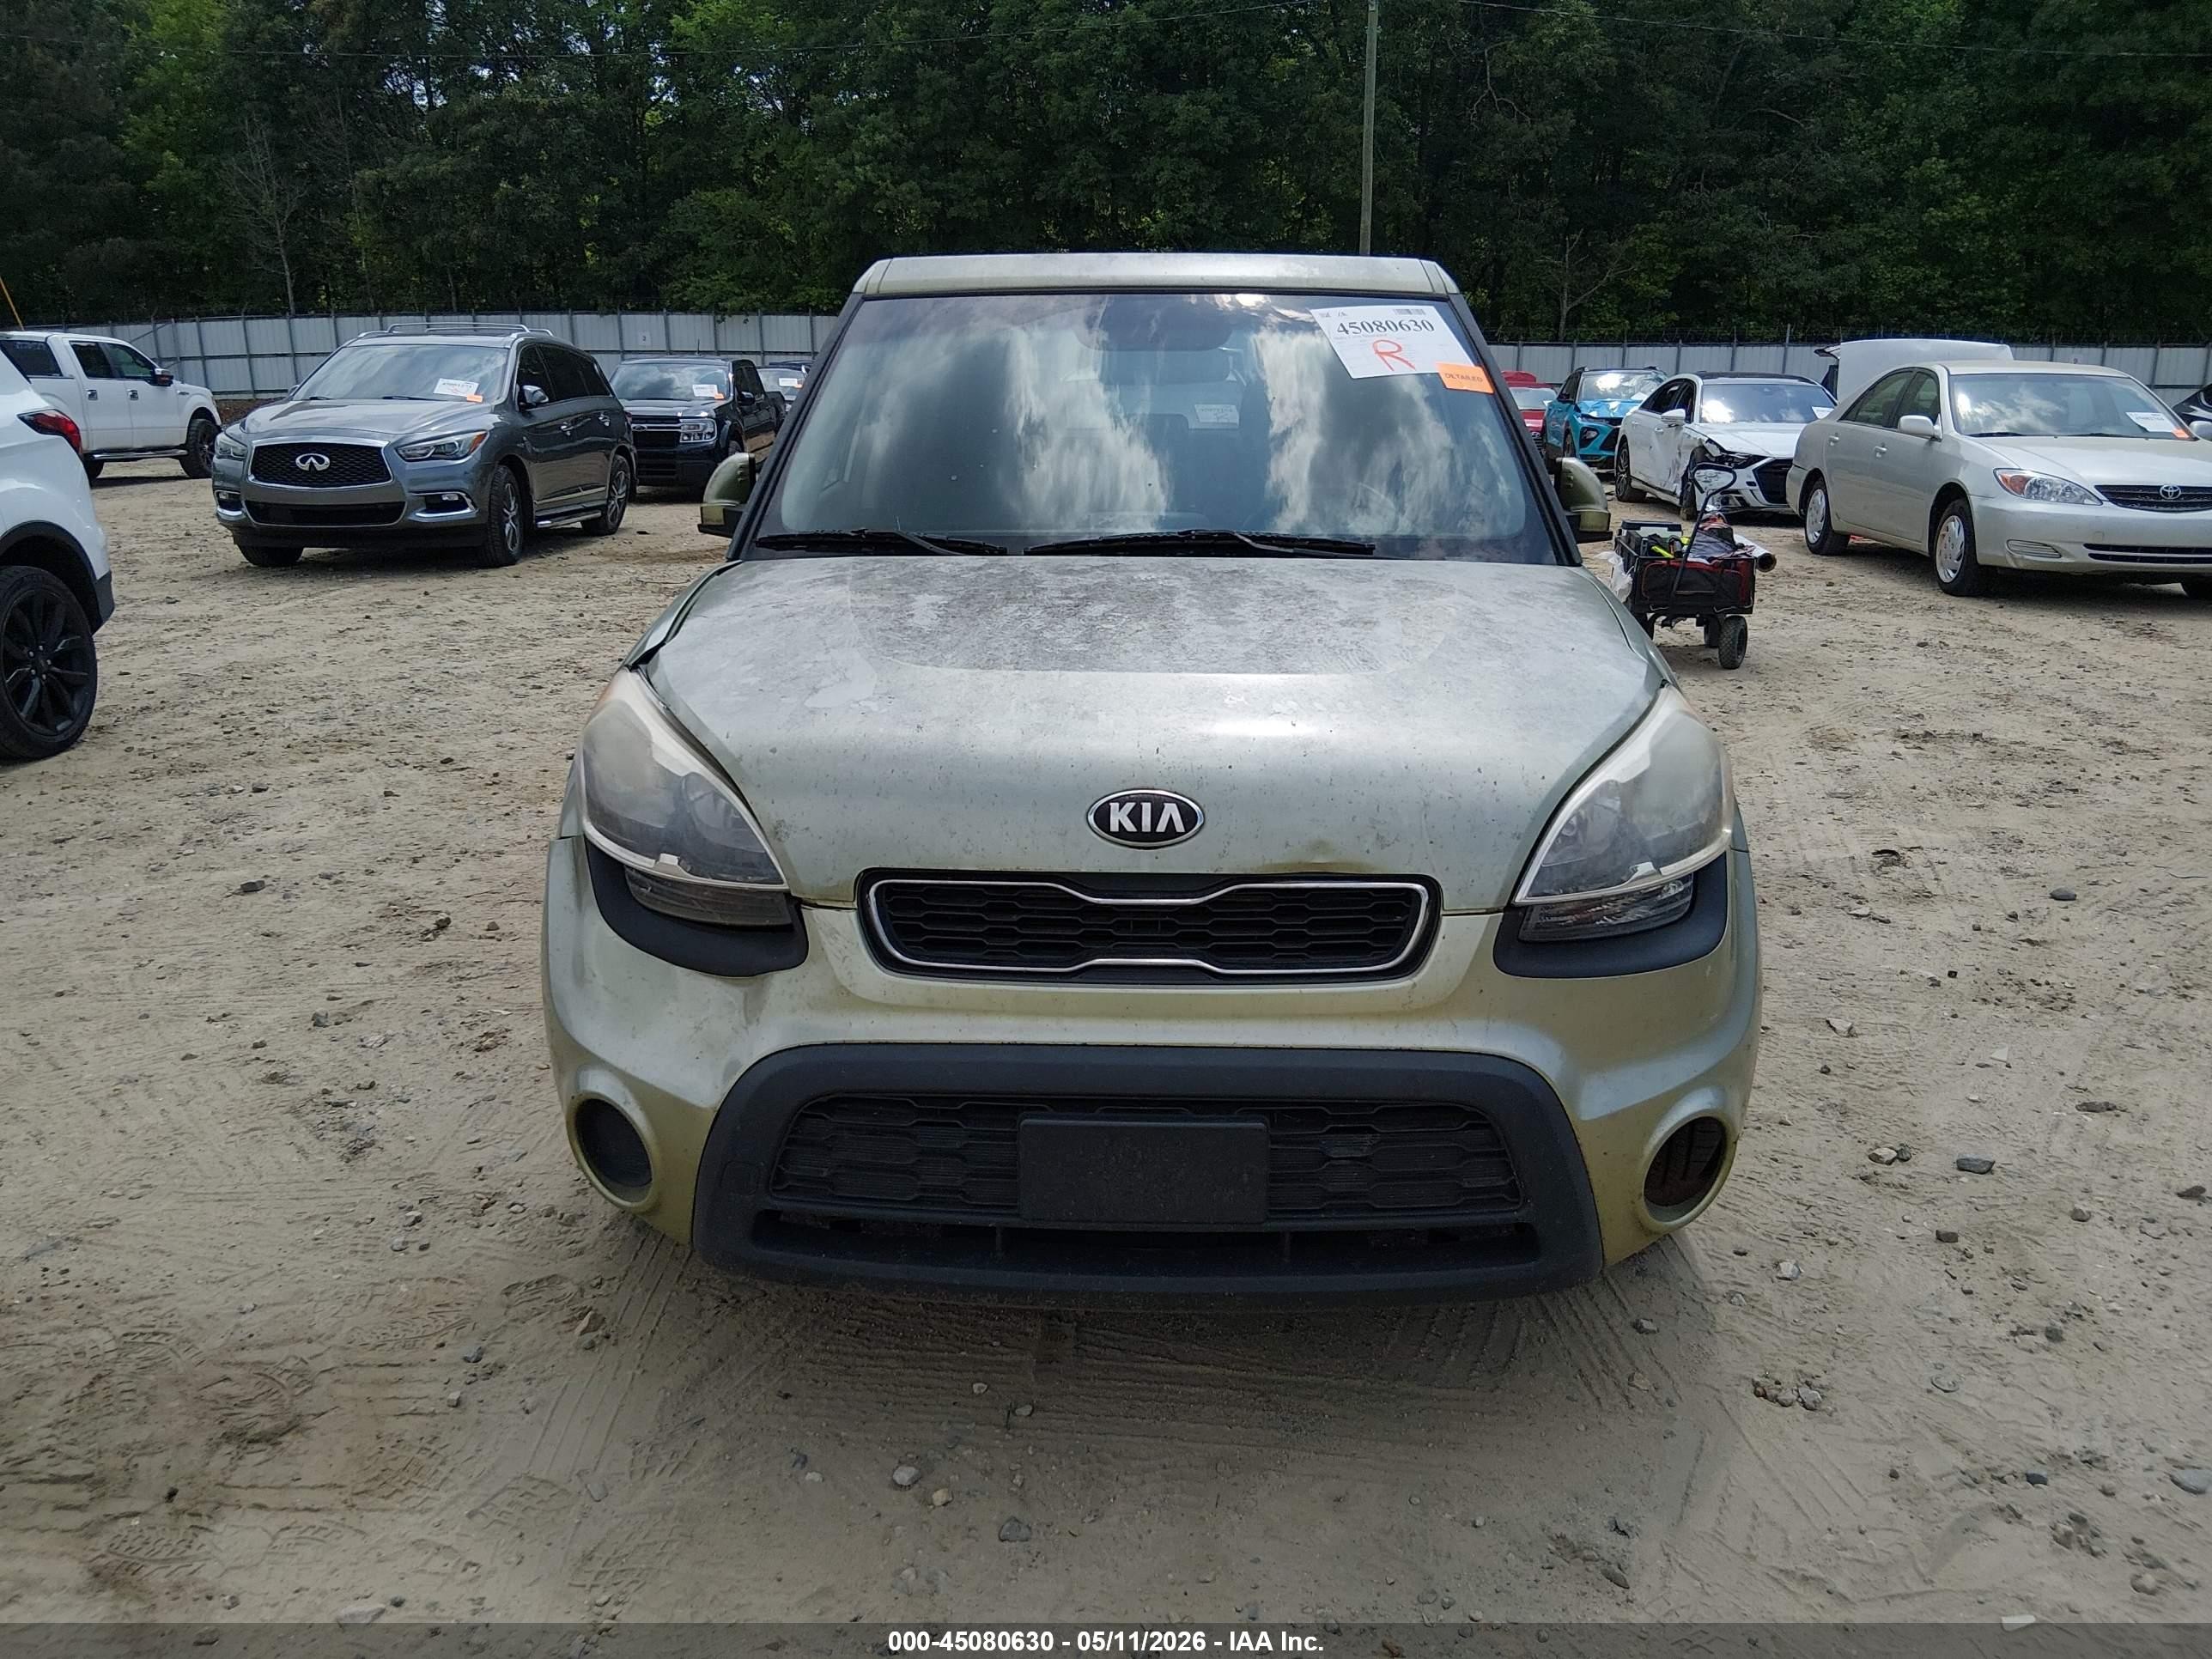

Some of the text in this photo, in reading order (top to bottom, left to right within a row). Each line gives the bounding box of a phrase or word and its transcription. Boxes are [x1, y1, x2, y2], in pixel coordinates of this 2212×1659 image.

[1337, 319, 1435, 335] 45080630
[1372, 339, 1416, 372] R
[1109, 801, 1186, 833] KIA
